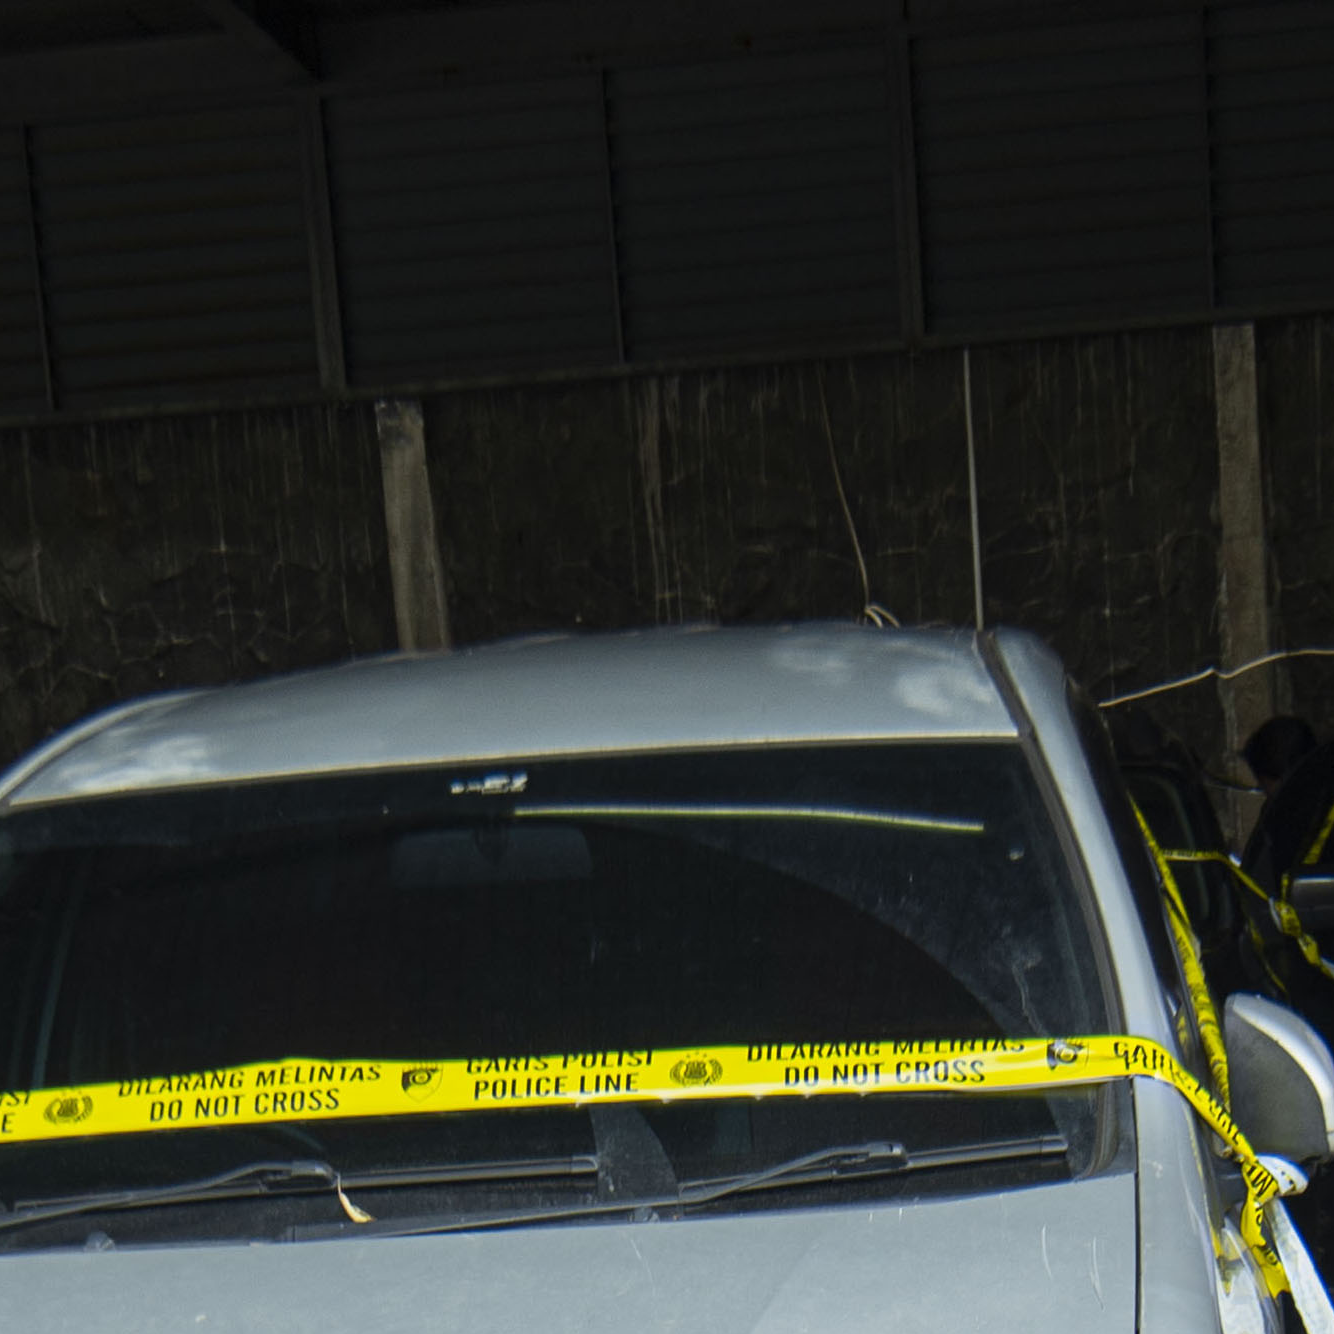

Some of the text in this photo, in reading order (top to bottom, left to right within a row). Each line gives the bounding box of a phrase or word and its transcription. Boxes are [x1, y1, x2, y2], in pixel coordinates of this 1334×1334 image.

[118, 1064, 381, 1097] DILARANG MELINTAS
[474, 1073, 640, 1100] POLICE LINE
[784, 1060, 986, 1087] DO NOT CROSS
[150, 1088, 340, 1122] DO NOT CROSS
